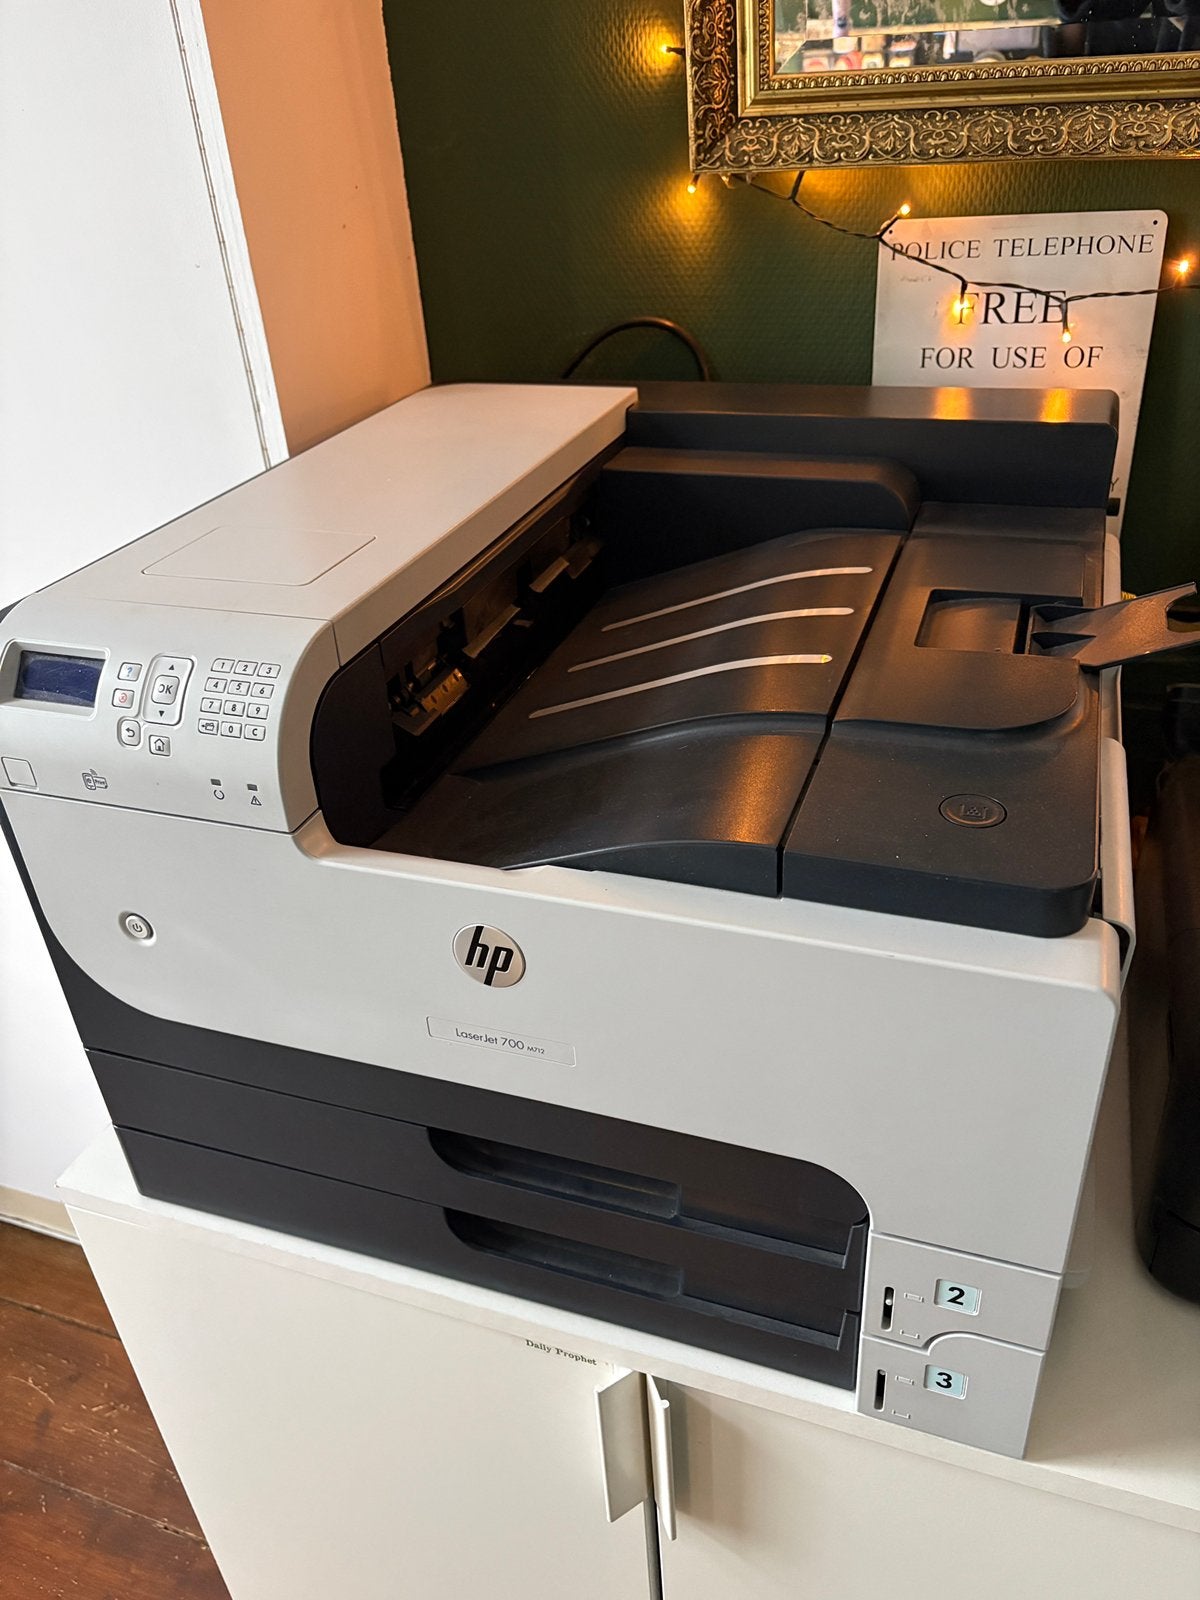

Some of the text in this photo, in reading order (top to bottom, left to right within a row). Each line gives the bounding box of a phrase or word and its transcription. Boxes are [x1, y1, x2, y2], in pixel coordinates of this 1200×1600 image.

[891, 234, 1155, 261] POLICE TELEPHONE
[954, 290, 1068, 325] FREE
[919, 345, 1104, 370] FOR USE OF
[242, 664, 249, 672] 2
[265, 667, 272, 675] 3
[158, 683, 174, 695] OK
[213, 681, 219, 689] 4
[235, 682, 242, 691] 5
[259, 687, 265, 695] 6
[208, 701, 214, 709] 7
[231, 704, 237, 712] 8
[255, 706, 261, 715] 9
[251, 728, 258, 737] C
[464, 925, 514, 987] hp
[455, 1027, 546, 1055] LaserJet 700 M712
[947, 1286, 965, 1306] 2
[524, 1339, 597, 1366] Daily Prophet
[935, 1371, 953, 1389] 3
